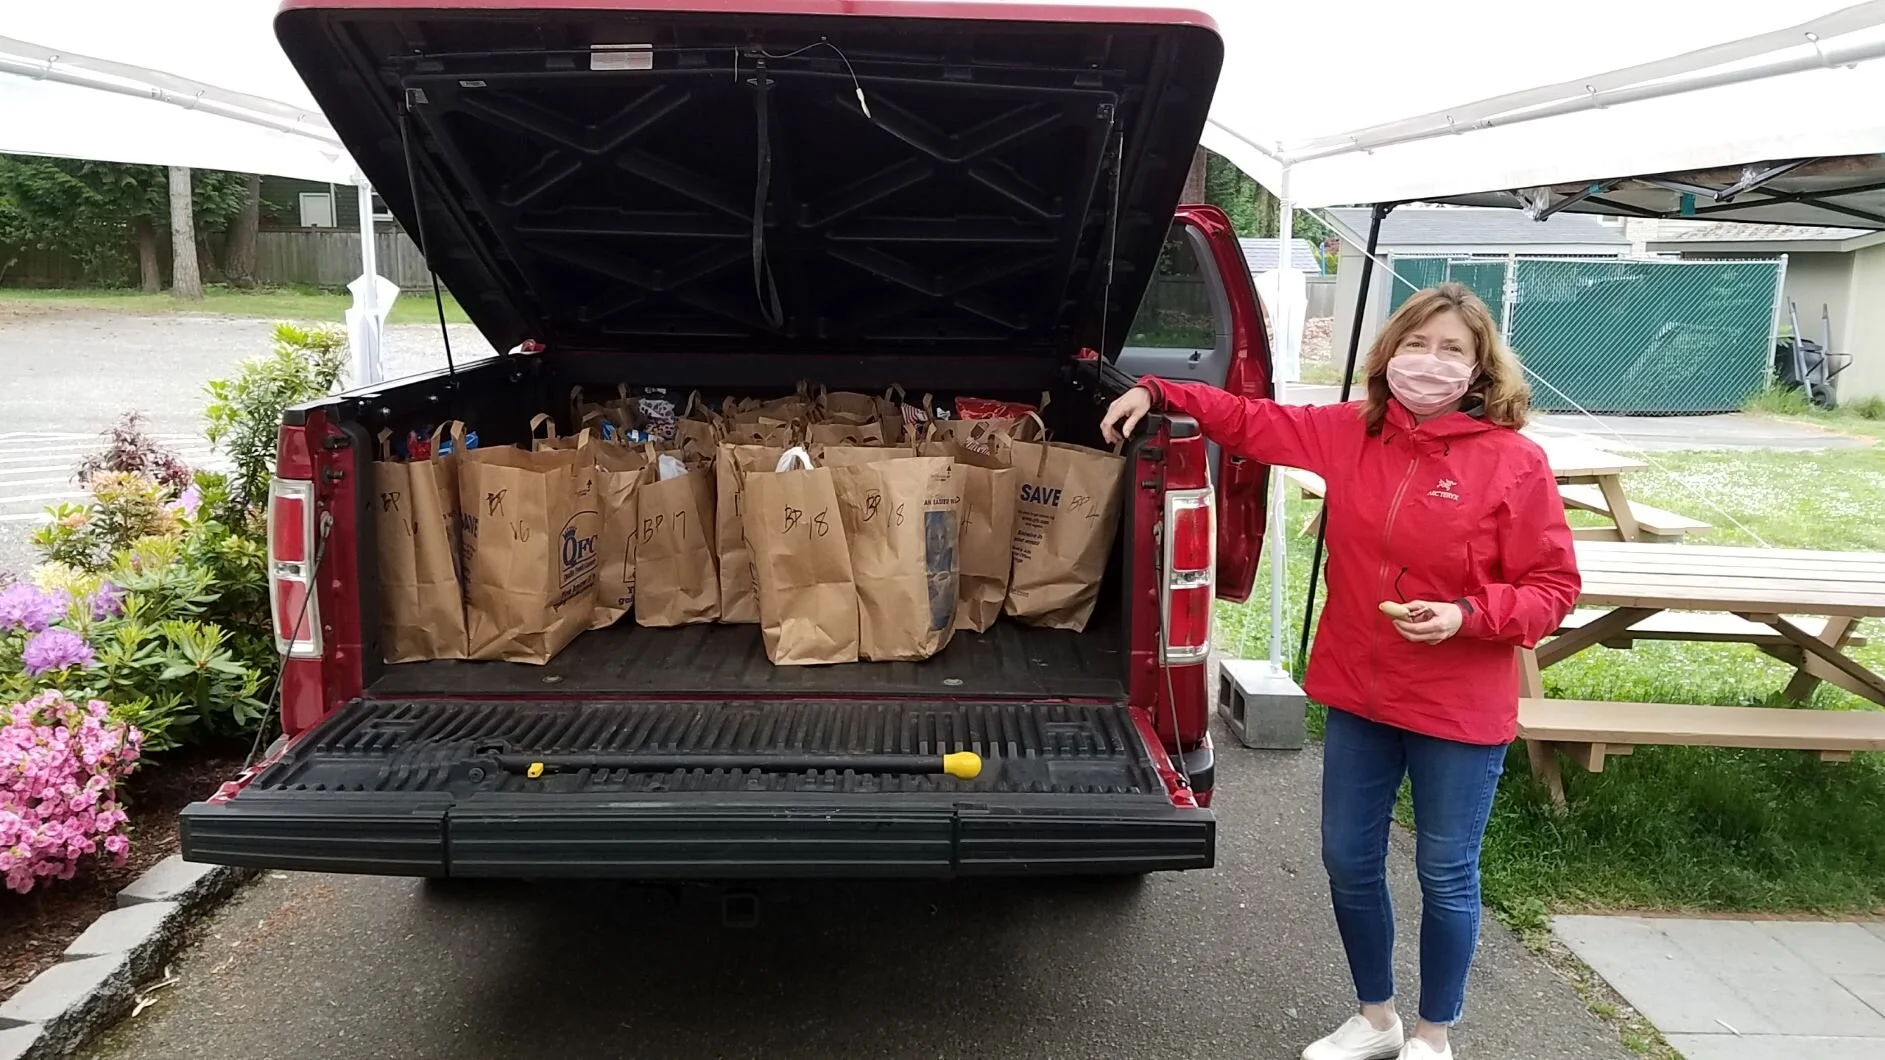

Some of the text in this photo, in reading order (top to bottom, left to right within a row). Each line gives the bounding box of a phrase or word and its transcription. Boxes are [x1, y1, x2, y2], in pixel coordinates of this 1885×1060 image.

[1020, 484, 1062, 507] SAVE
[643, 511, 686, 545] BP 17
[782, 504, 829, 540] BP 18
[887, 501, 904, 528] 18
